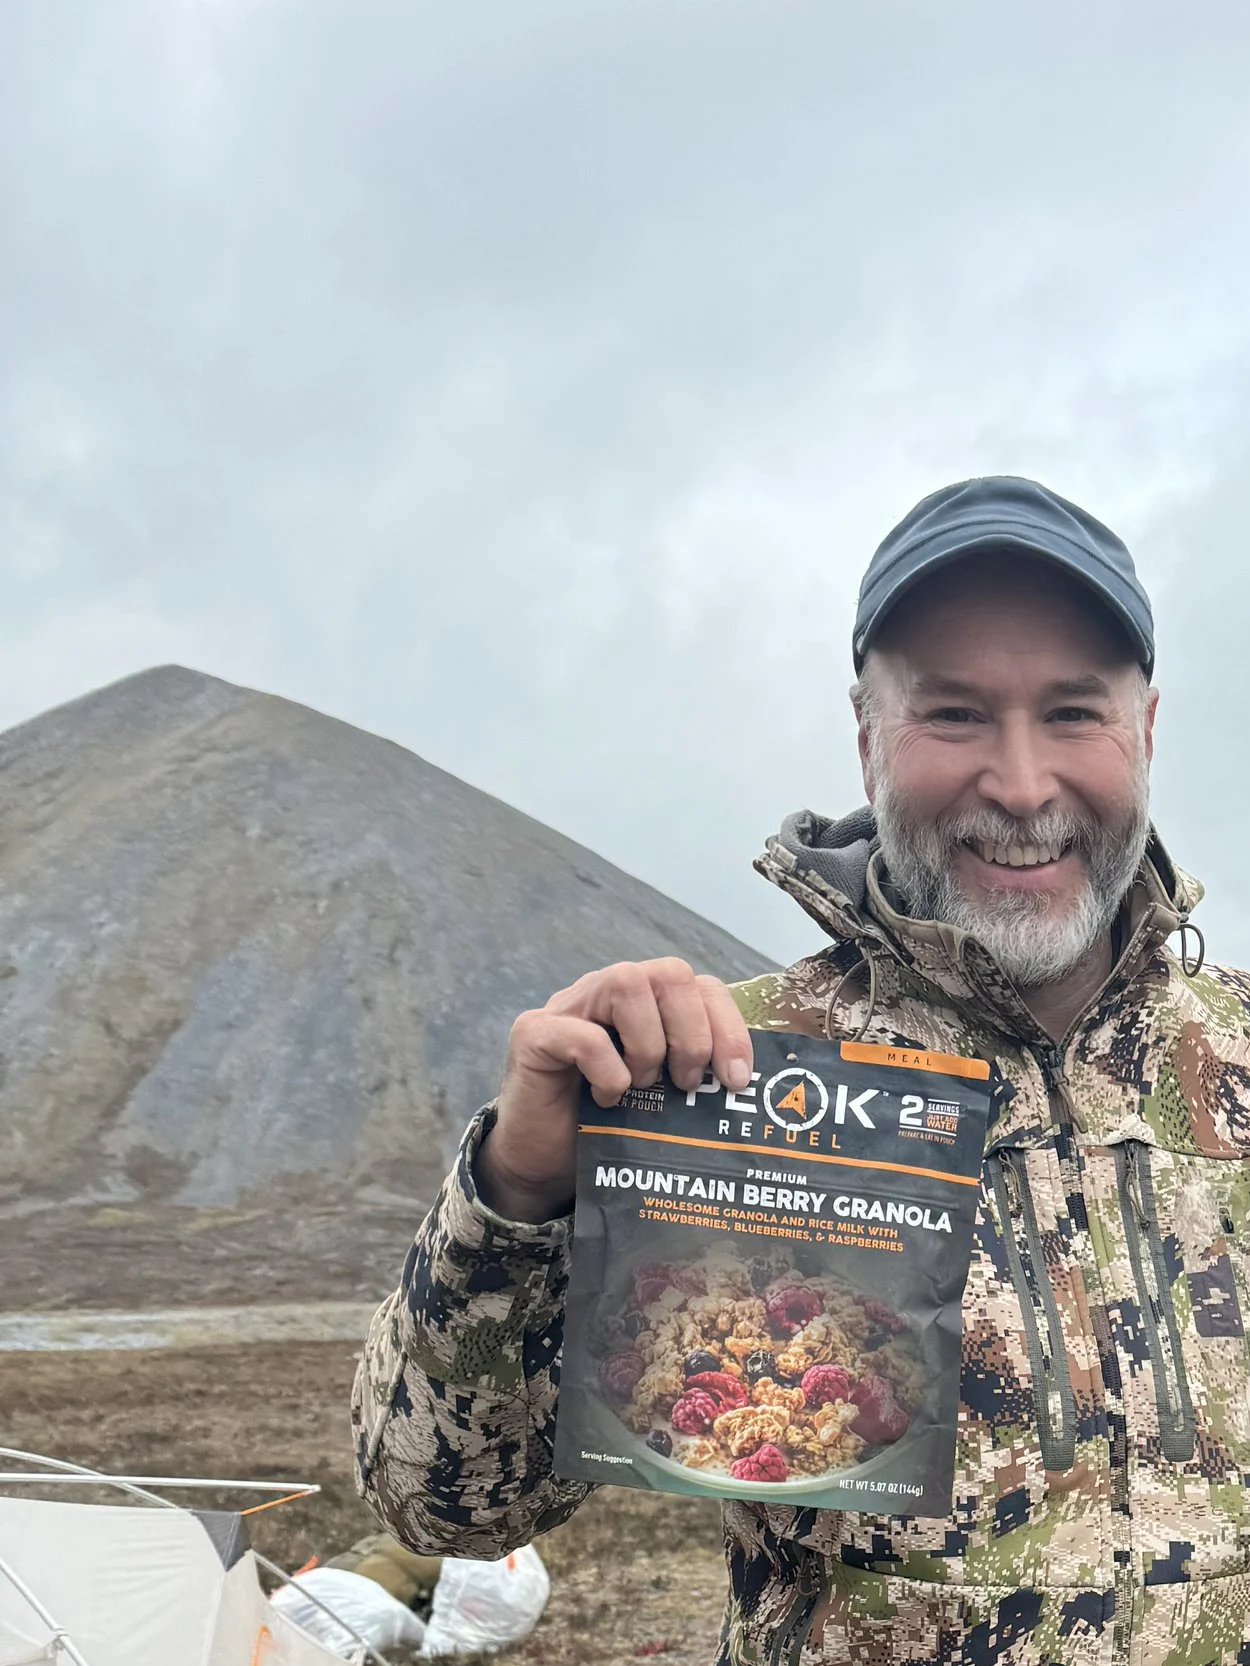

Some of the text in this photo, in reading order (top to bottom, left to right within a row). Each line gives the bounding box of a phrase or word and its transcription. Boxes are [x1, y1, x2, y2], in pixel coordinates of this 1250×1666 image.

[887, 1053, 931, 1066] MEAL
[631, 1099, 664, 1112] POUCH
[899, 1094, 924, 1127] 2
[928, 1103, 960, 1114] SERVINGS
[717, 1119, 842, 1150] REFUEL
[927, 1119, 958, 1132] WATER
[746, 1168, 808, 1186] PREMIUM
[595, 1165, 953, 1234] MOUNTAIN BERRY GRANOLA
[643, 1196, 899, 1239] WHOLESOME GRANOLA AND RICE MILK WITH
[639, 1208, 904, 1252] STRAWBERRIES, BLUEBERRIES, & RASPBERRIES
[581, 1450, 633, 1465] Serving Suggestion
[839, 1479, 923, 1497] NET WT 5.07 OZ (144g)
